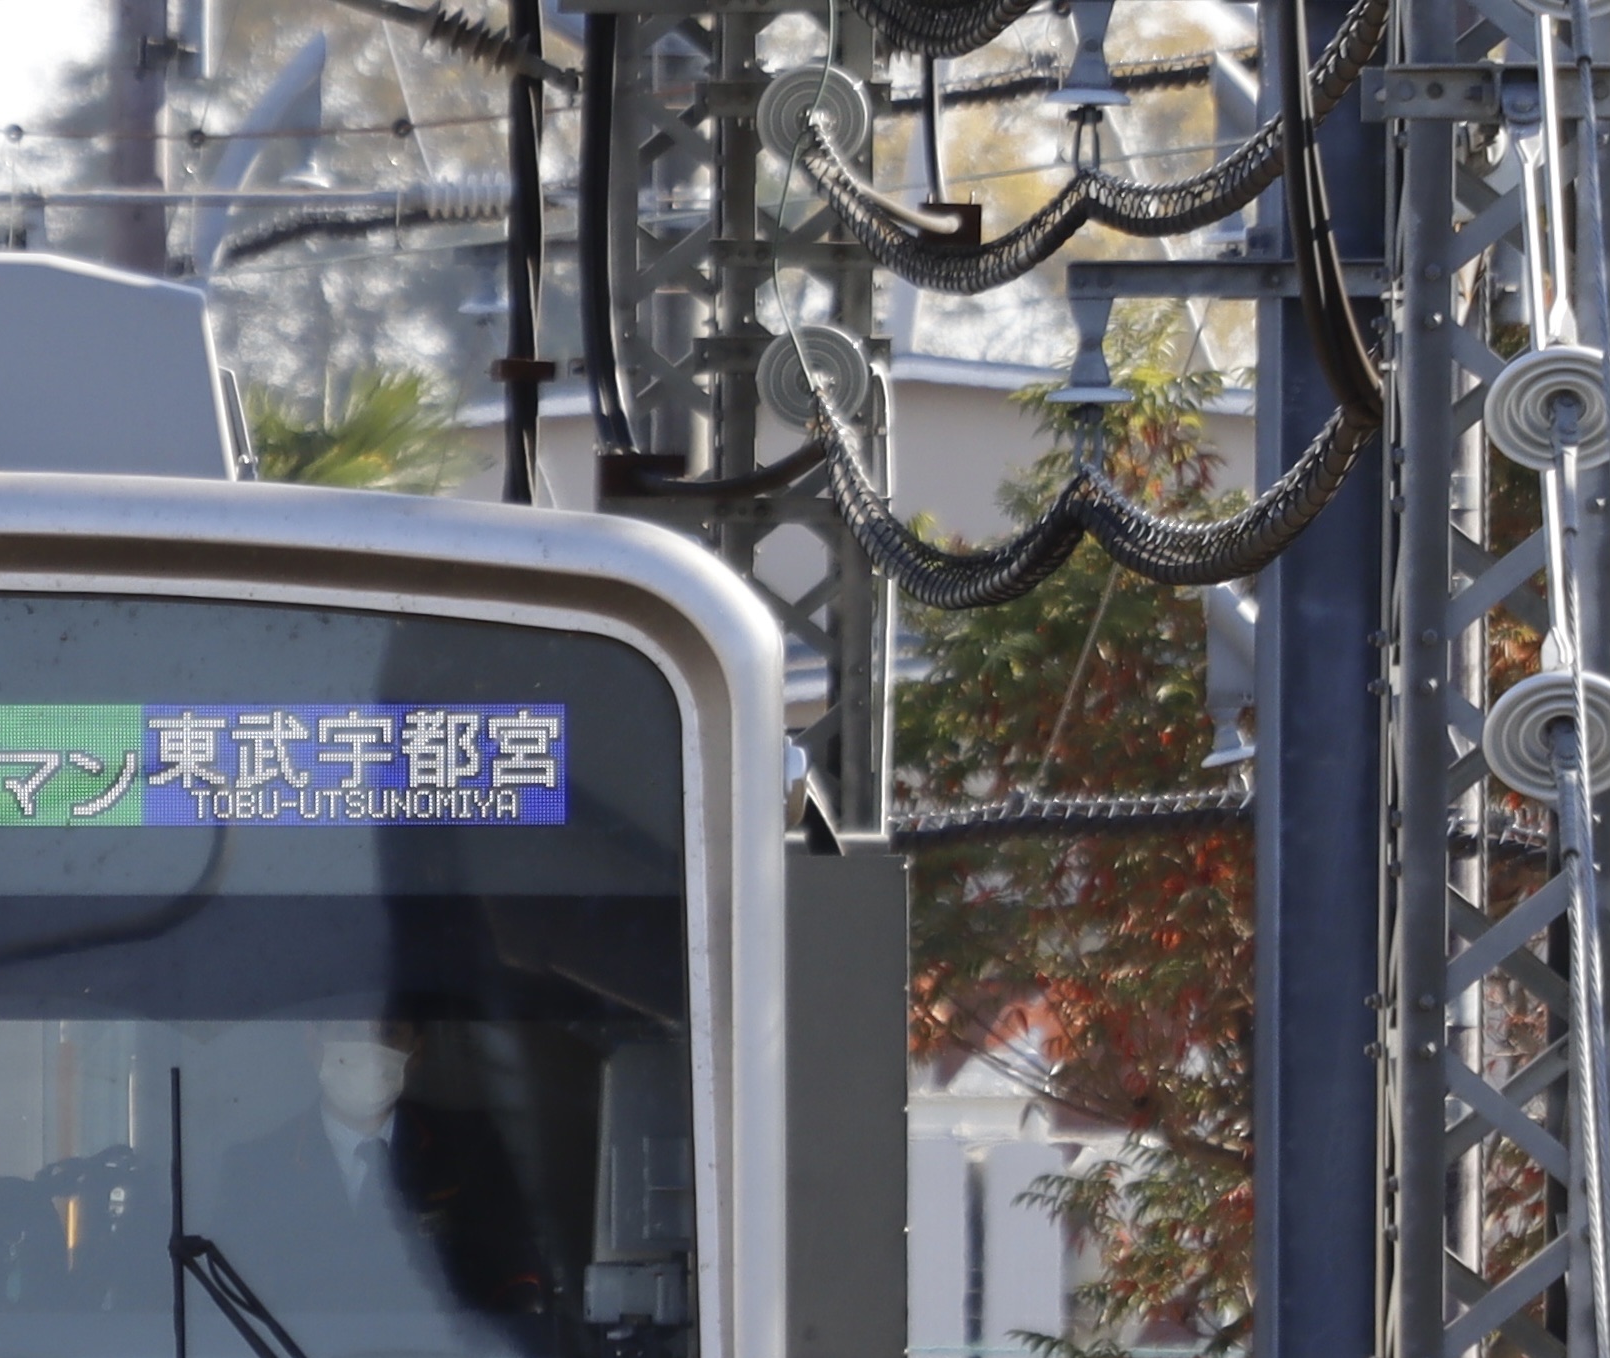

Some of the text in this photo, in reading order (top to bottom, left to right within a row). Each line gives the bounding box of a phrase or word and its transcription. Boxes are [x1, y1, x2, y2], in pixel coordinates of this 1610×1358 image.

[147, 711, 559, 788] 東武宇都宮
[191, 791, 519, 820] TOBU-UTSUNOMIYA
